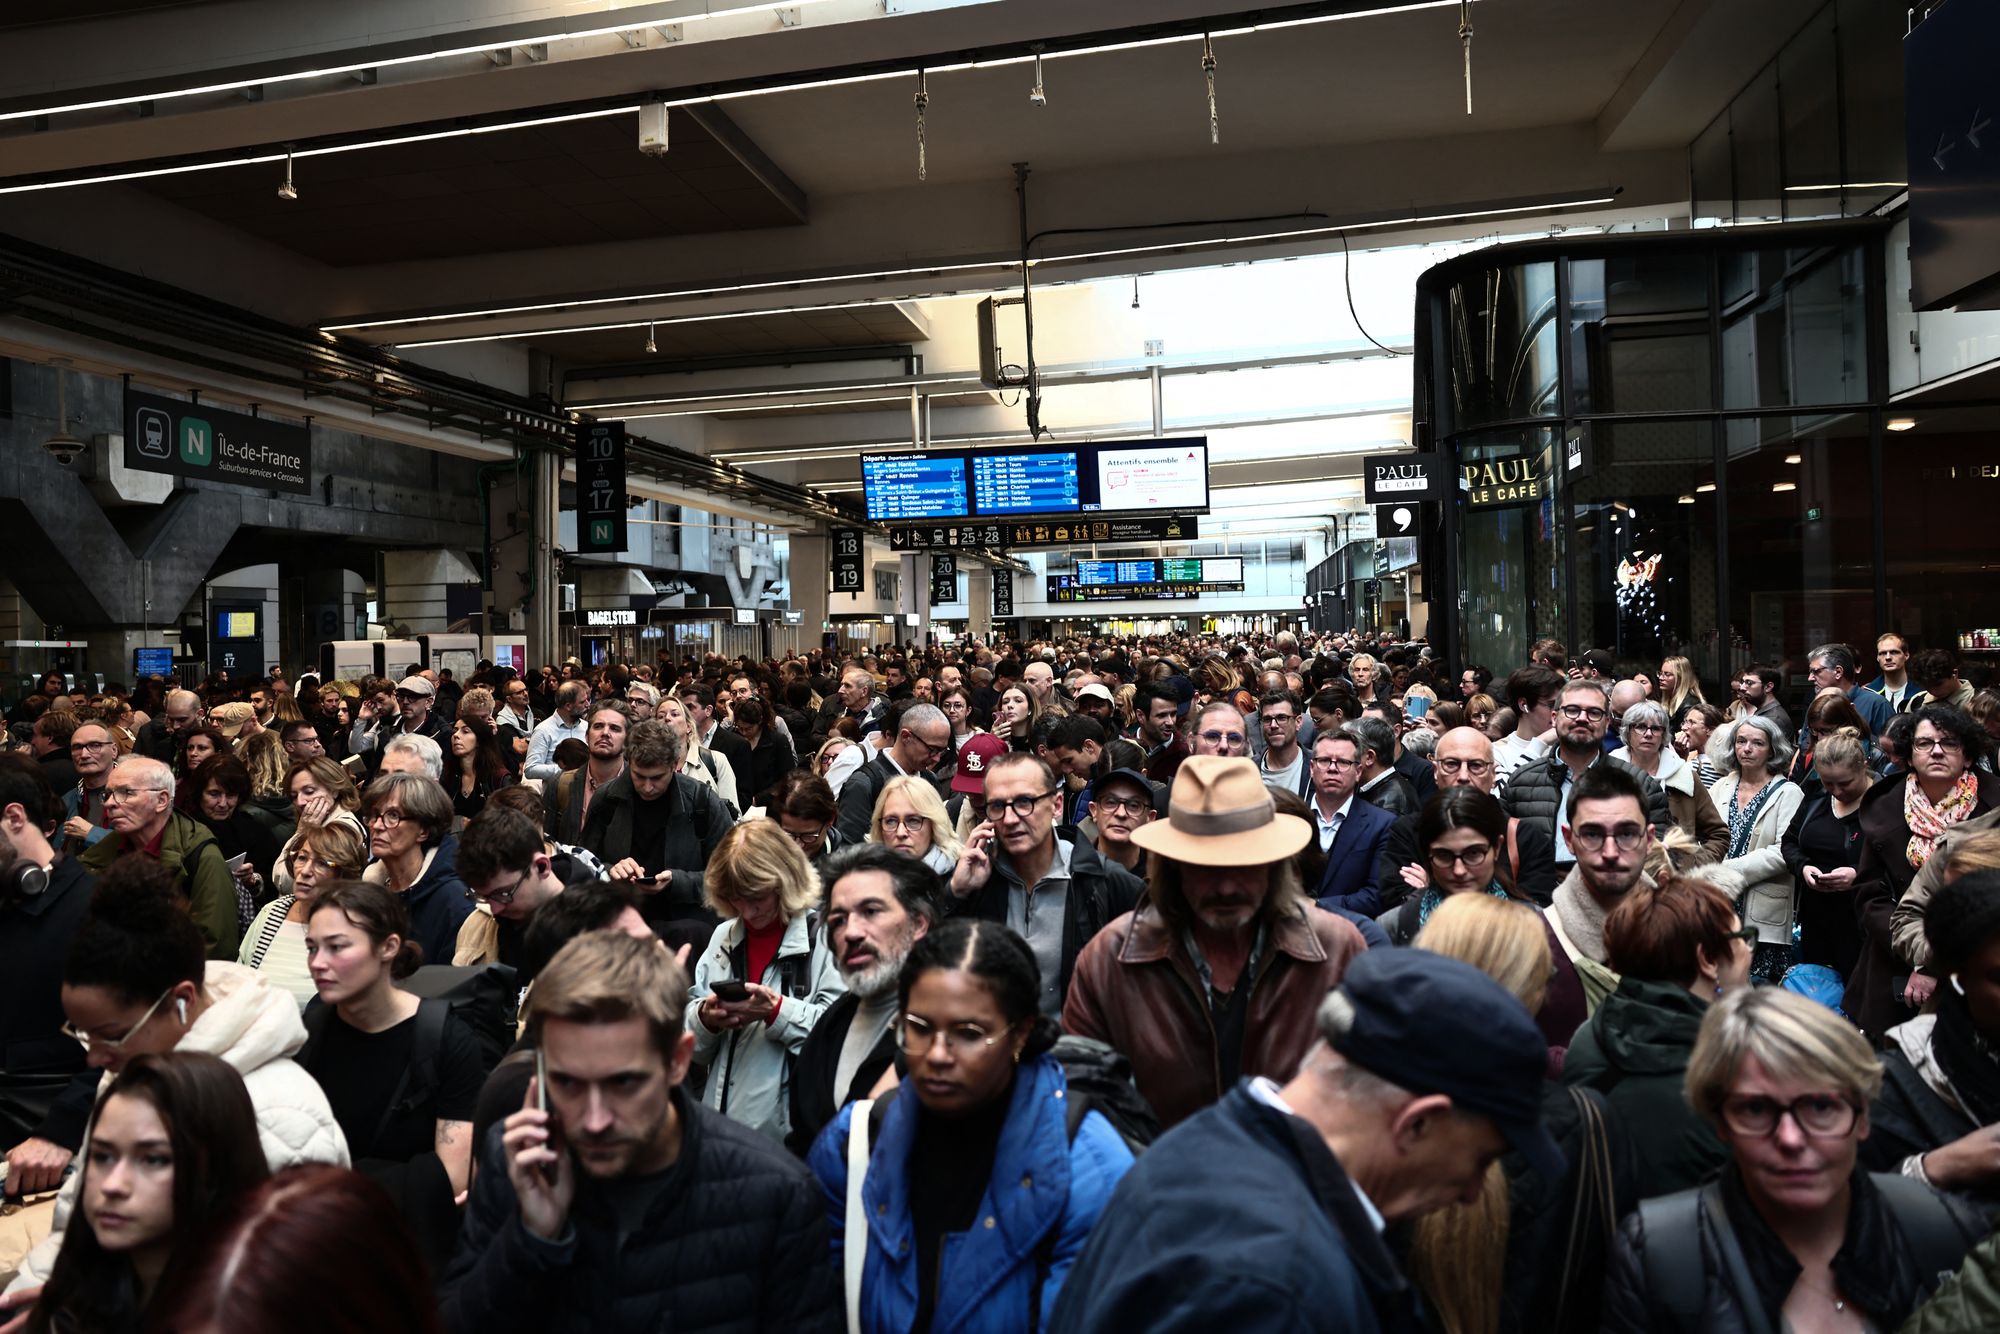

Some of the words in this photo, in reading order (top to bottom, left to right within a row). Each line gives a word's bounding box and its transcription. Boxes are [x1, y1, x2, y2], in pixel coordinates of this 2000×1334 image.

[188, 427, 203, 456] N
[588, 437, 613, 457] 10
[218, 432, 301, 470] Île-de-France
[219, 460, 248, 474] Suburban
[250, 466, 272, 479] services
[1375, 464, 1428, 480] PAUL
[1465, 458, 1540, 488] PAUL
[589, 489, 614, 510] 17
[1472, 491, 1489, 503] LE
[1497, 482, 1537, 500] CAFÉ
[596, 525, 608, 539] N
[961, 533, 976, 543] 25
[985, 532, 999, 542] 28
[839, 539, 857, 553] 18
[938, 562, 952, 573] 20
[840, 571, 858, 585] 19
[875, 569, 892, 600] Hall
[939, 586, 952, 597] 21
[588, 611, 636, 625] BAGELSTEIN
[224, 657, 235, 666] 17
